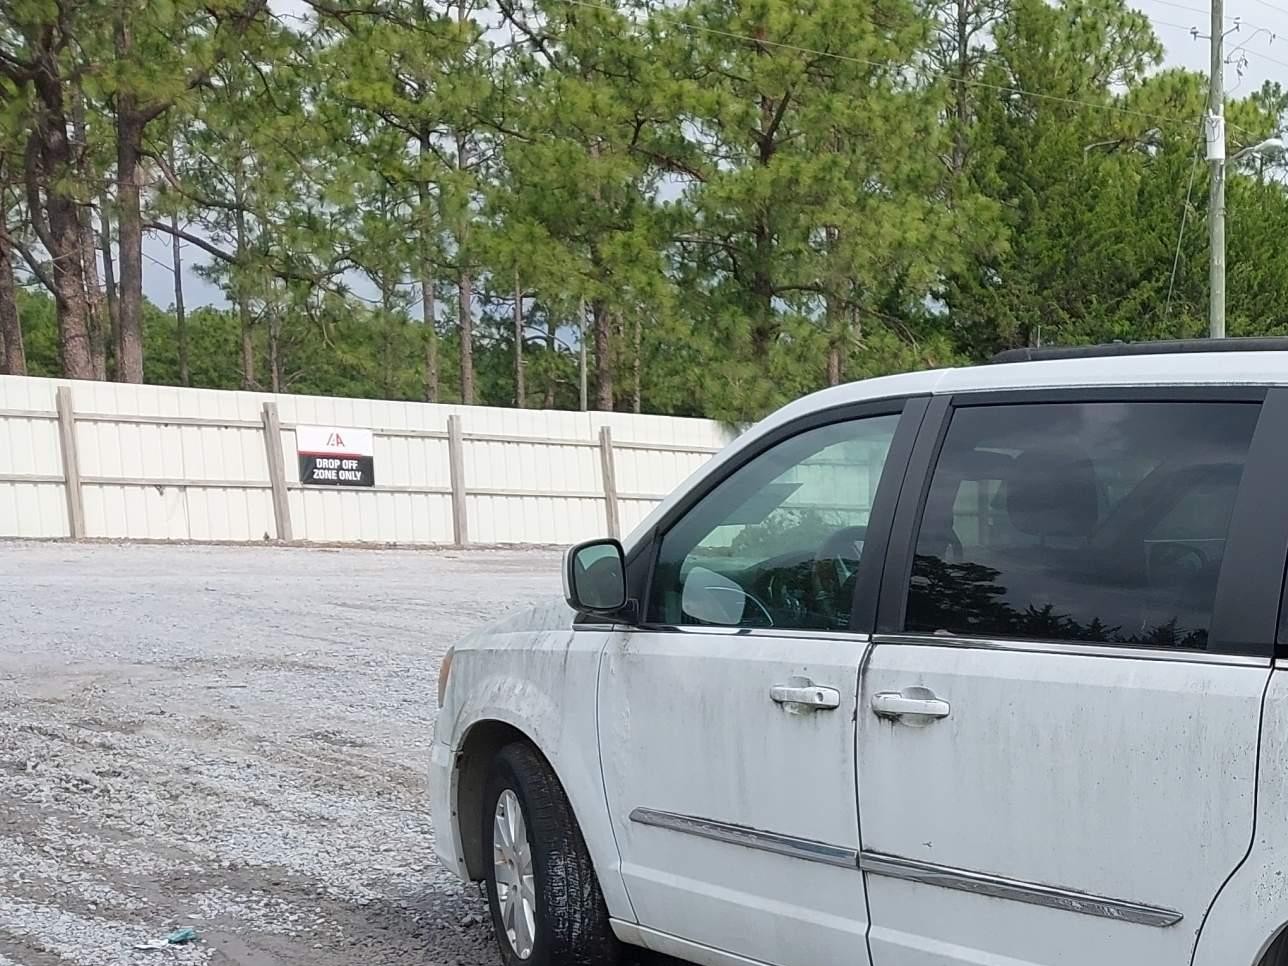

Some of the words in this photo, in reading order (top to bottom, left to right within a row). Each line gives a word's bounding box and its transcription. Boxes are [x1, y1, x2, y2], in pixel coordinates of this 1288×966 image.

[315, 458, 340, 469] DROP
[342, 459, 358, 470] OFF
[313, 469, 337, 479] ZONE
[339, 470, 361, 481] ONLY
